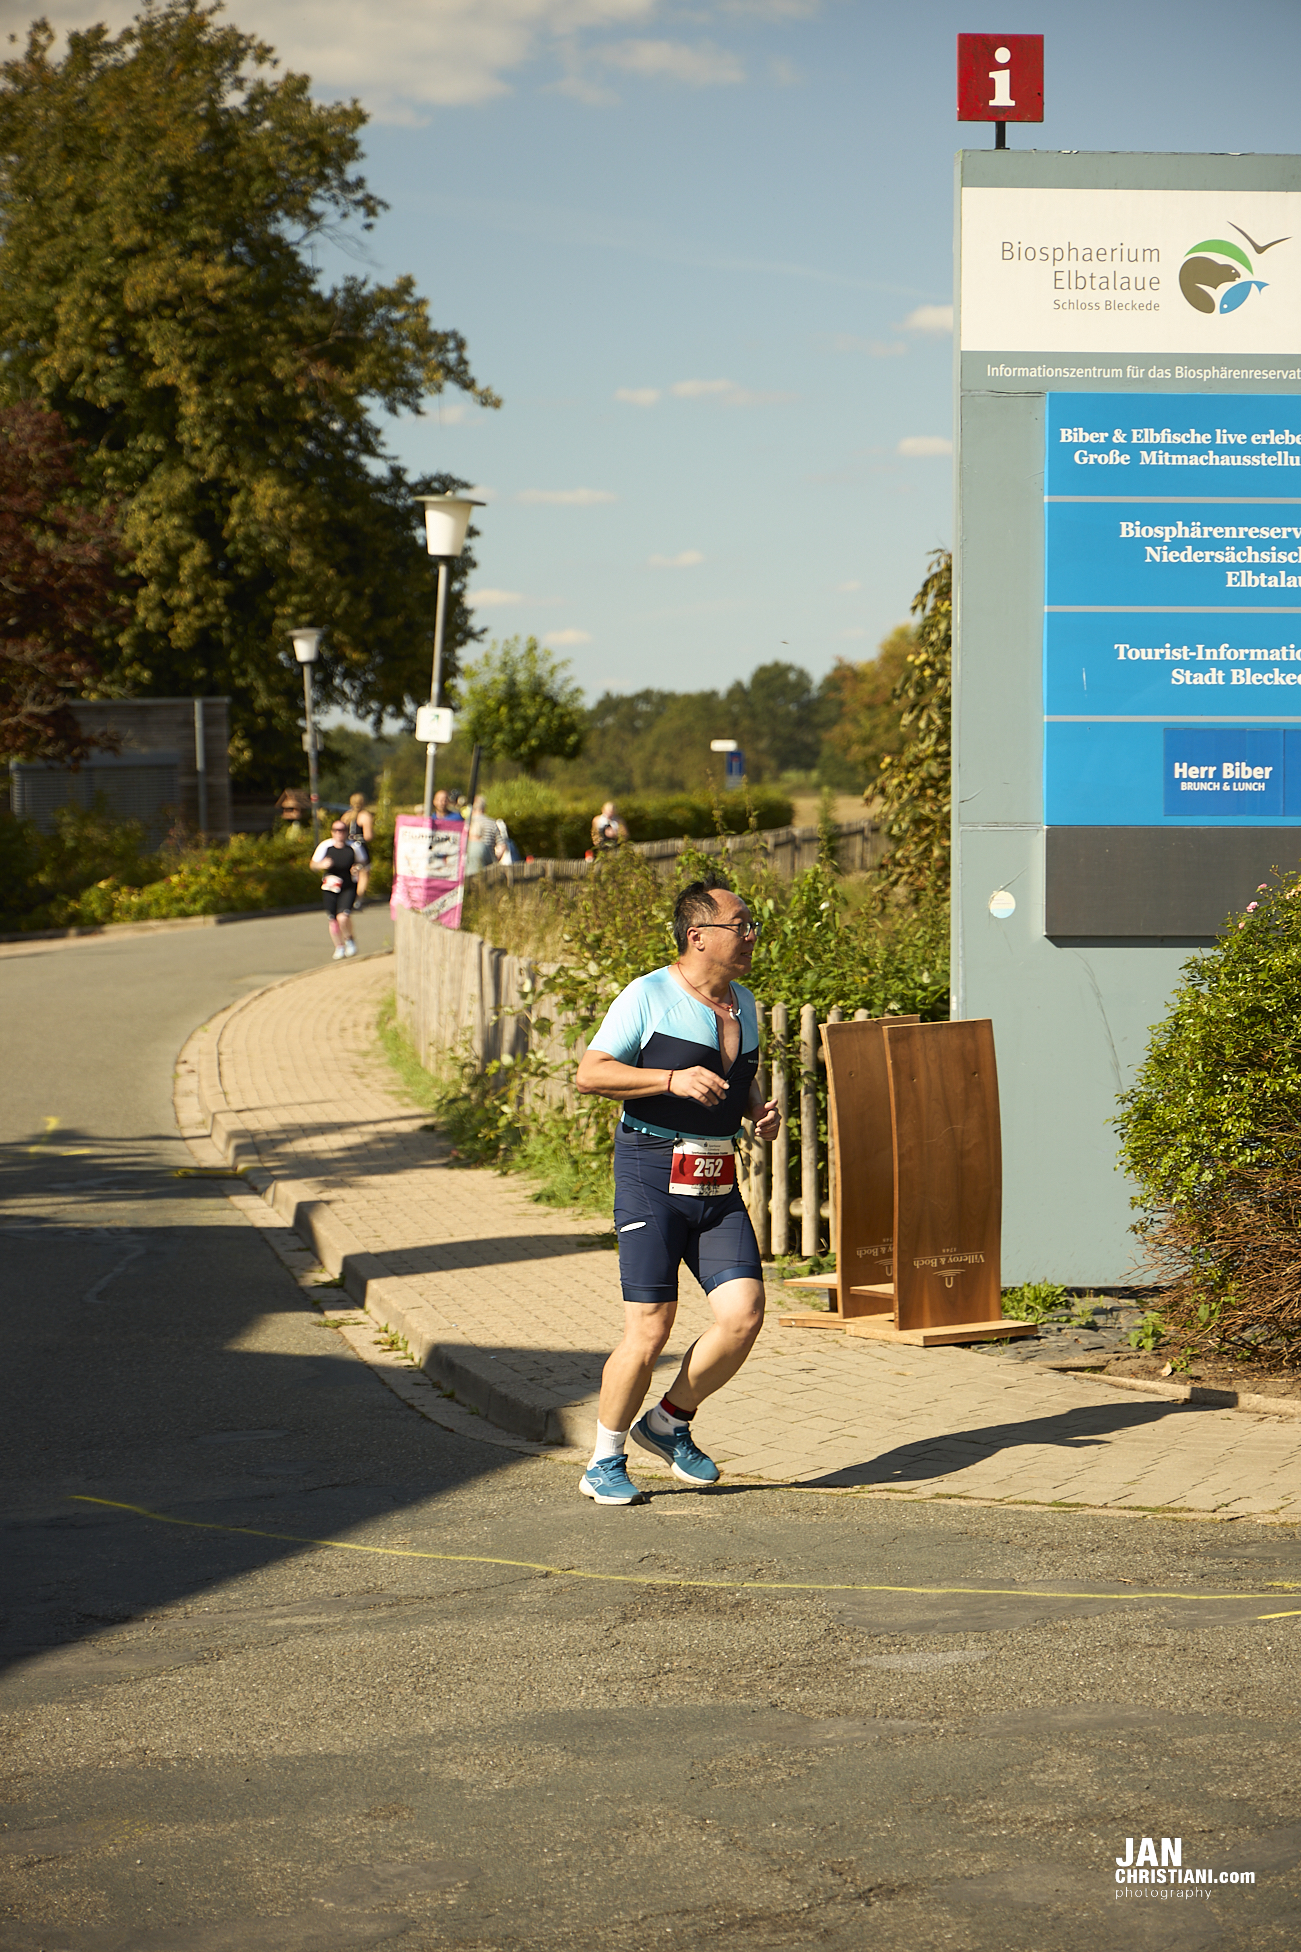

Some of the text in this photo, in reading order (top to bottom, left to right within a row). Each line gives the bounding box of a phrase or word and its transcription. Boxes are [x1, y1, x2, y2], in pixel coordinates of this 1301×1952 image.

[989, 46, 1016, 107] i
[1000, 241, 1161, 267] Biosphaerium
[1053, 270, 1161, 291] Elbtalaue
[1053, 299, 1160, 312] Schloss Bleckede
[987, 364, 1301, 382] Informationszentrum für das Biosphärenreservat
[1059, 427, 1109, 444] Biber
[1112, 428, 1128, 444] &
[1130, 428, 1212, 445] Elbfische
[1215, 429, 1247, 445] live
[1073, 449, 1131, 466] Große
[1119, 520, 1301, 543] Biosphärenreserv
[1225, 570, 1301, 588] Elbtala
[1170, 667, 1301, 686] Stadt Blecke
[1173, 762, 1273, 780] Herr Biber
[1180, 781, 1266, 792] BRUNCH & LUNCH
[693, 1158, 724, 1177] 252
[913, 1254, 986, 1269] Villeroy & Boch
